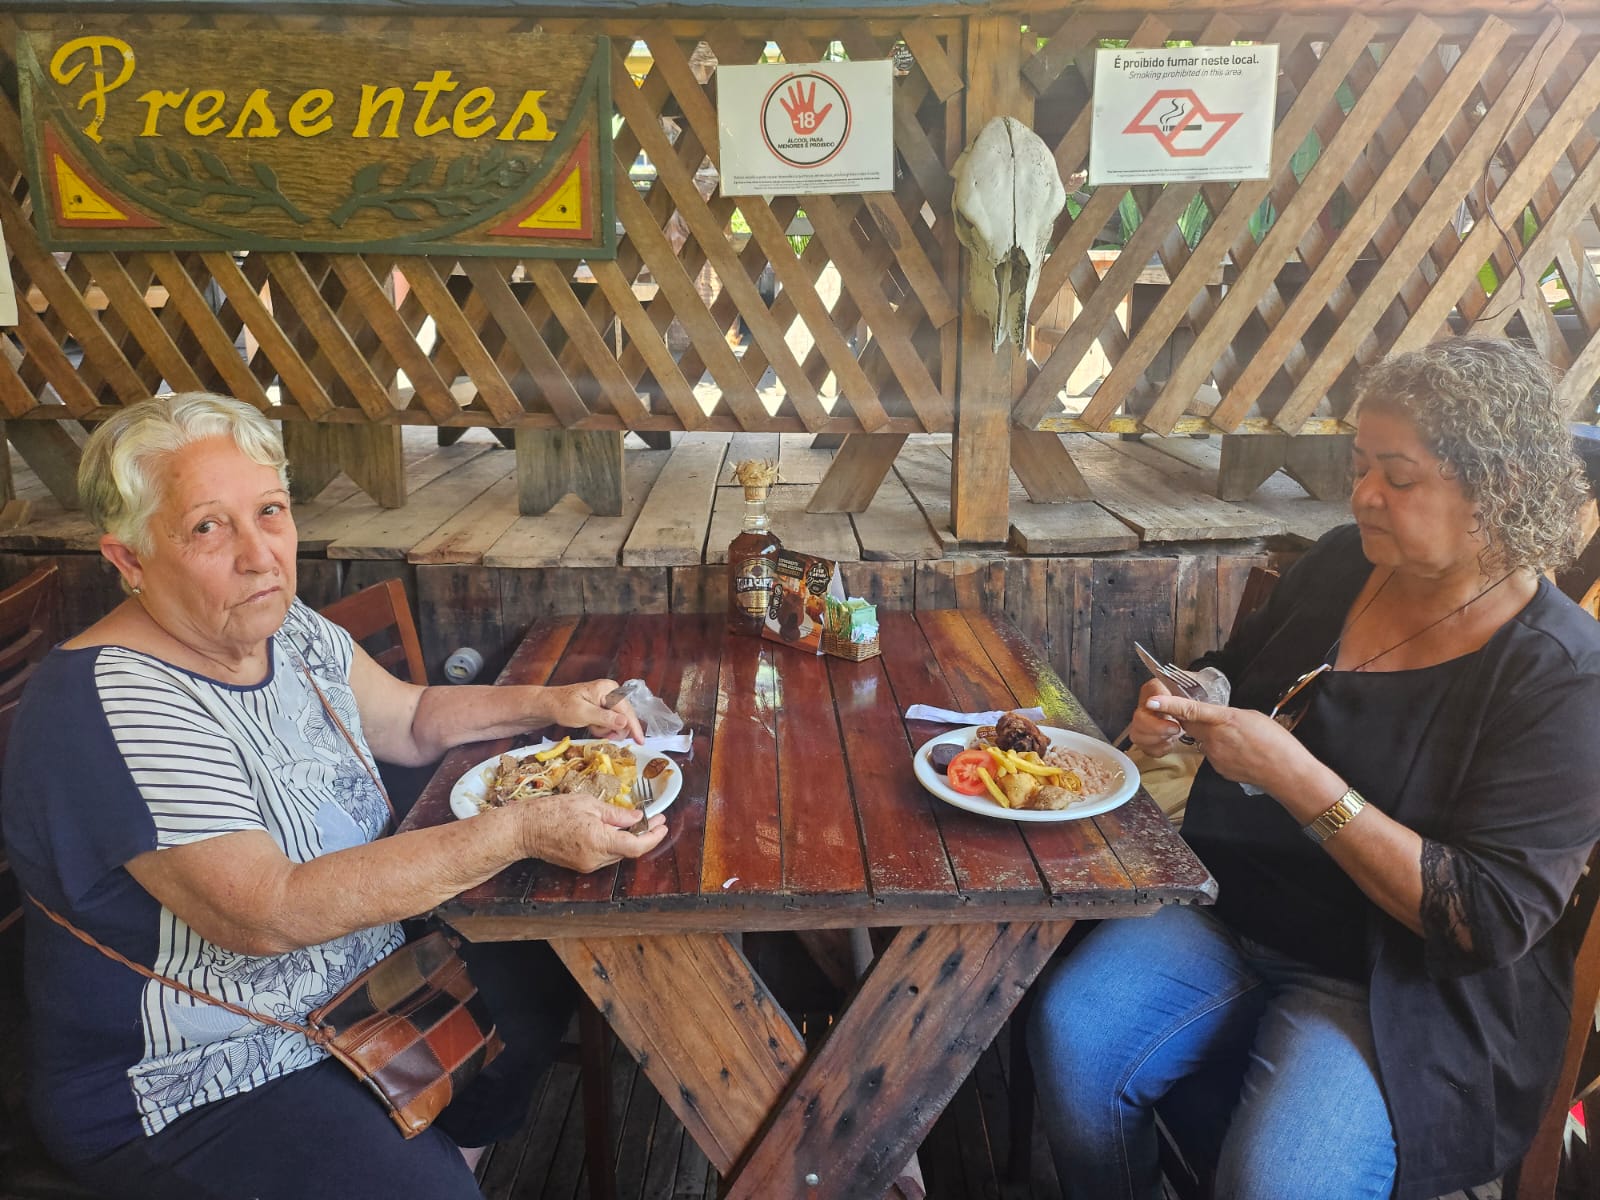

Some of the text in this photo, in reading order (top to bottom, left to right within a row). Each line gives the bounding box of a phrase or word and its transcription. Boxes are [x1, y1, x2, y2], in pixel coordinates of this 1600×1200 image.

[1114, 54, 1259, 70] É proibido fumar neste local.
[1129, 70, 1162, 80] Smoking
[1162, 69, 1200, 79] prohibited
[50, 36, 556, 143] Presentes
[793, 112, 815, 128] -18
